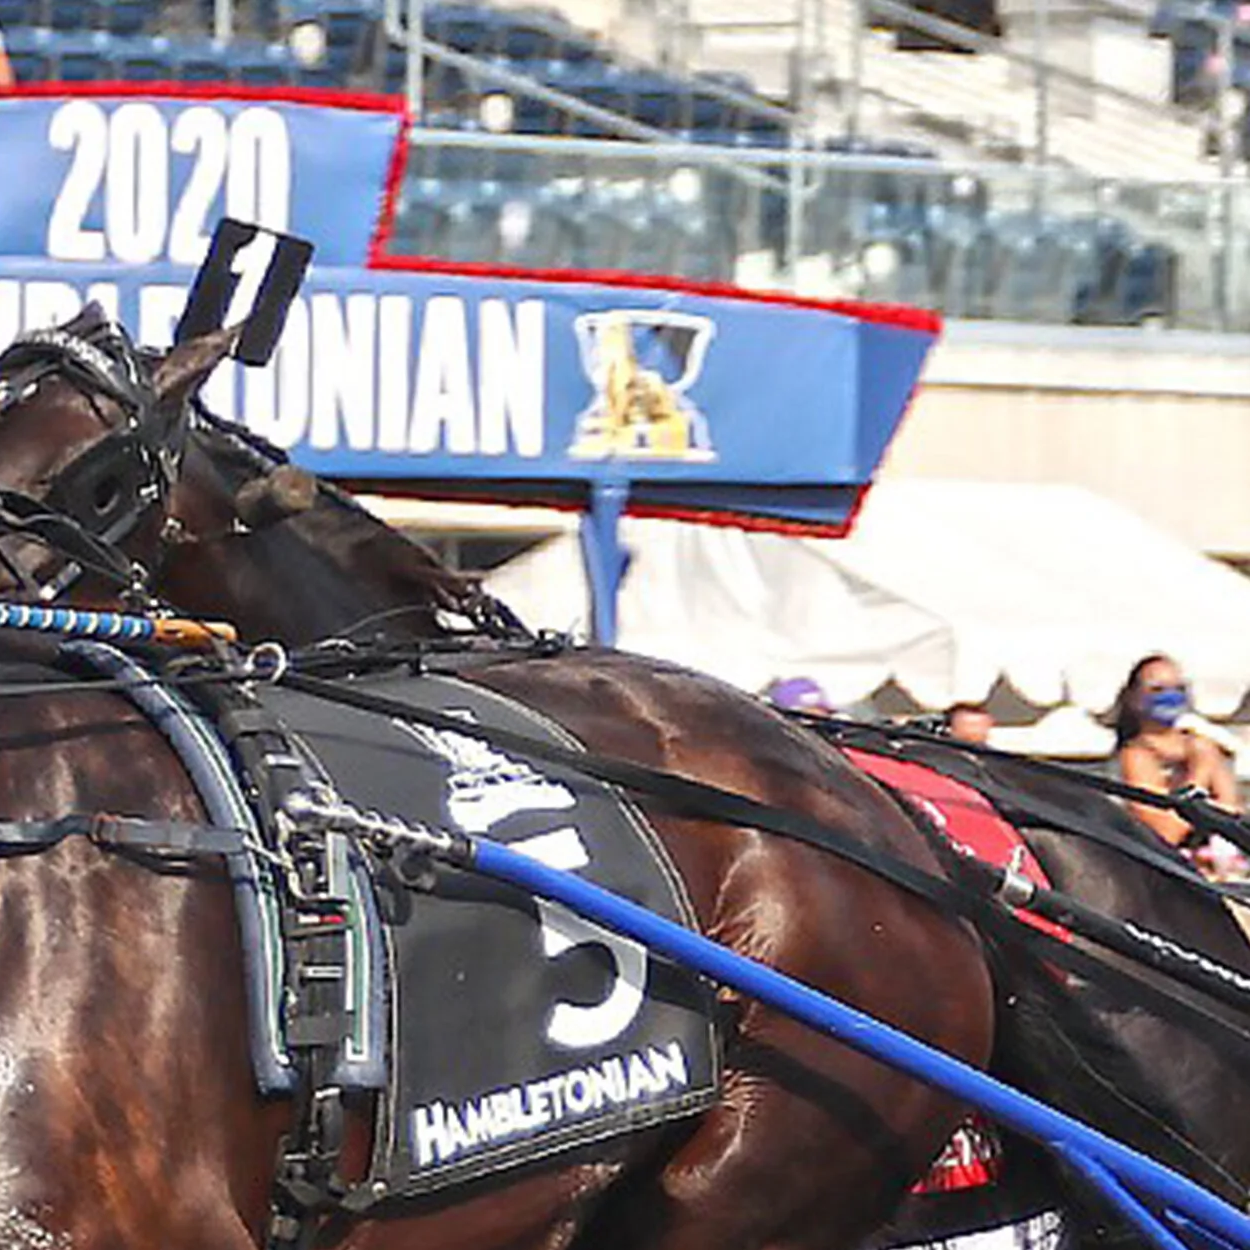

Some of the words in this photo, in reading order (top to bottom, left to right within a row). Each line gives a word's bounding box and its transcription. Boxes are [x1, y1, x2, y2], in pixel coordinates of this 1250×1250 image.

[47, 100, 291, 264] 2020
[222, 231, 278, 356] 1
[413, 1039, 689, 1167] HAMBLETONIAN
